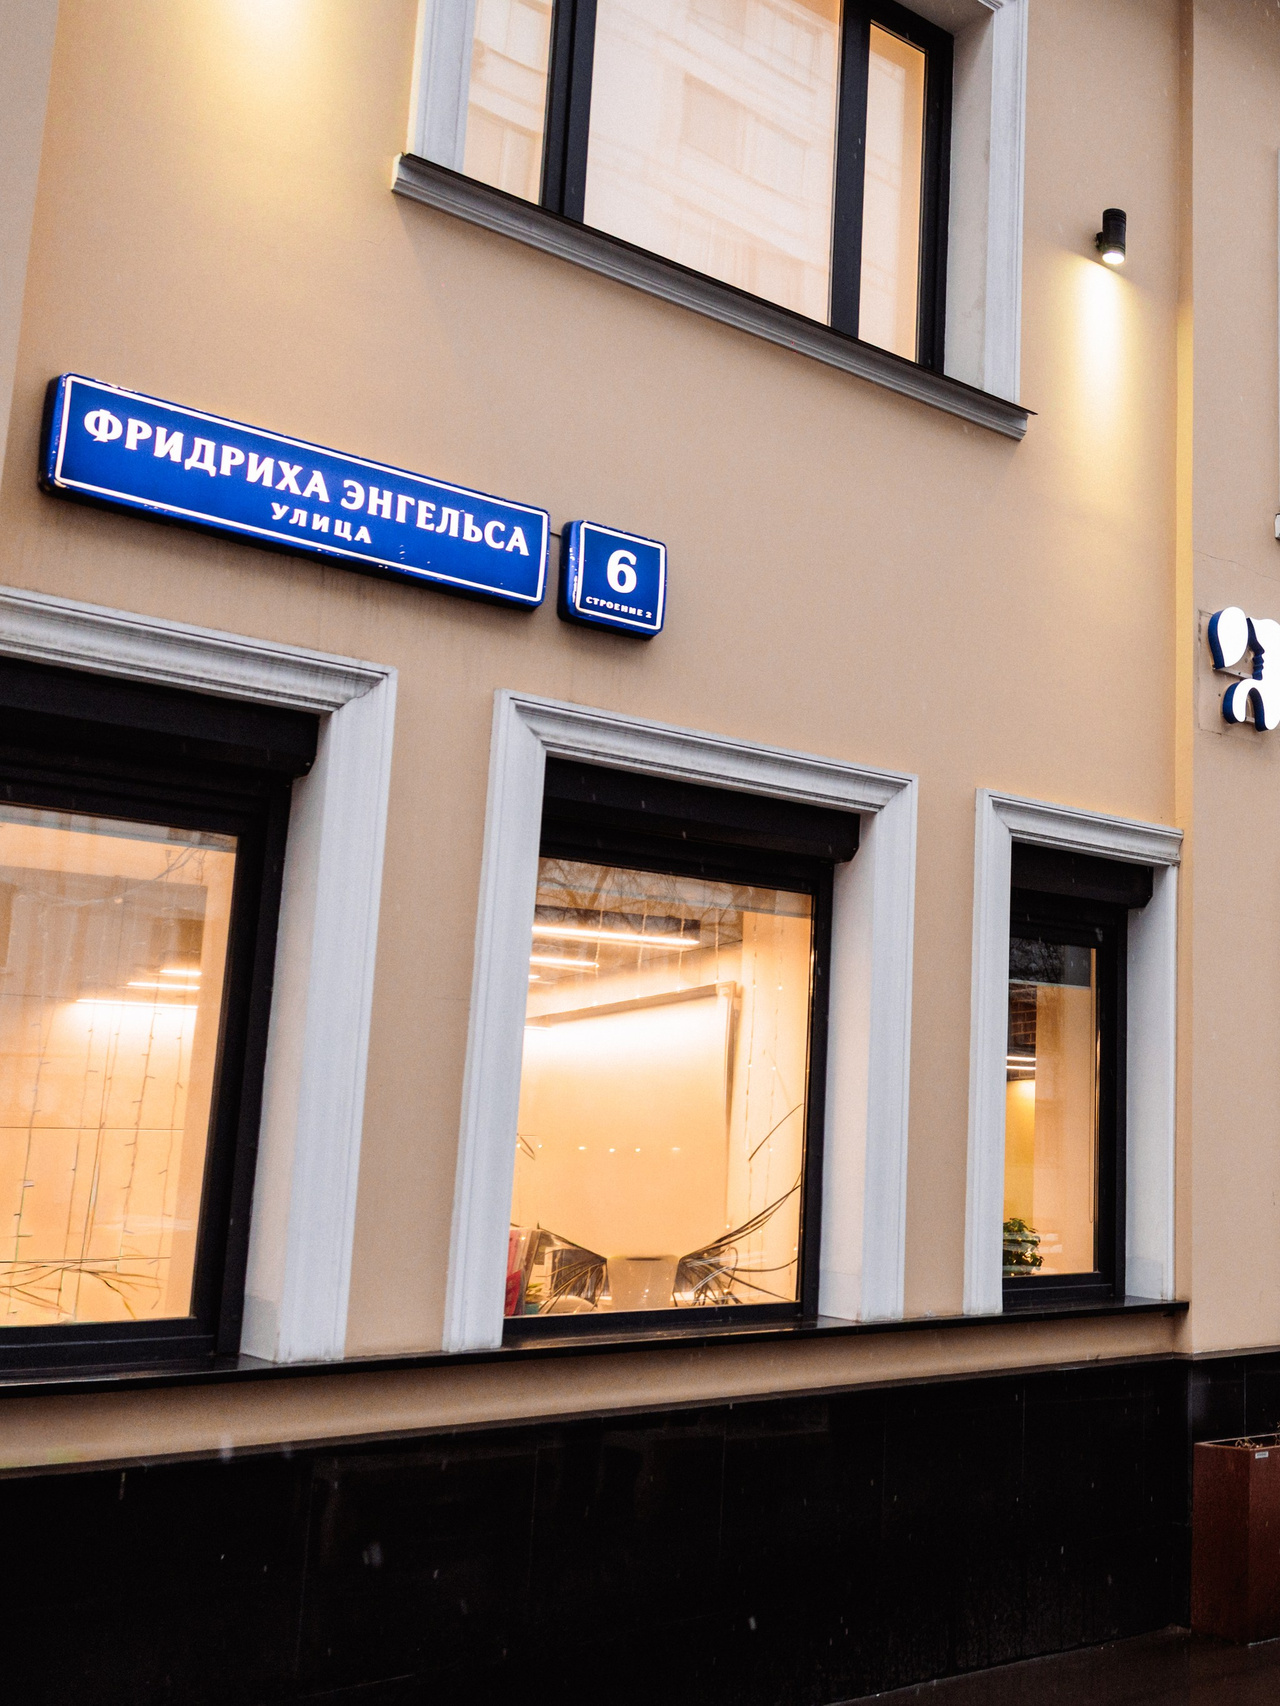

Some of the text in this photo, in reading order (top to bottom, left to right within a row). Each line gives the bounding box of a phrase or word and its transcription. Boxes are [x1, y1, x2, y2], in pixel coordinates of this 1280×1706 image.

[84, 408, 530, 557] ФРИДРИХА ЭНГЕЛЬСА
[271, 502, 372, 544] УЛИЦА
[606, 549, 637, 594] 6
[585, 596, 652, 619] СТРОЕНИЕ 2
